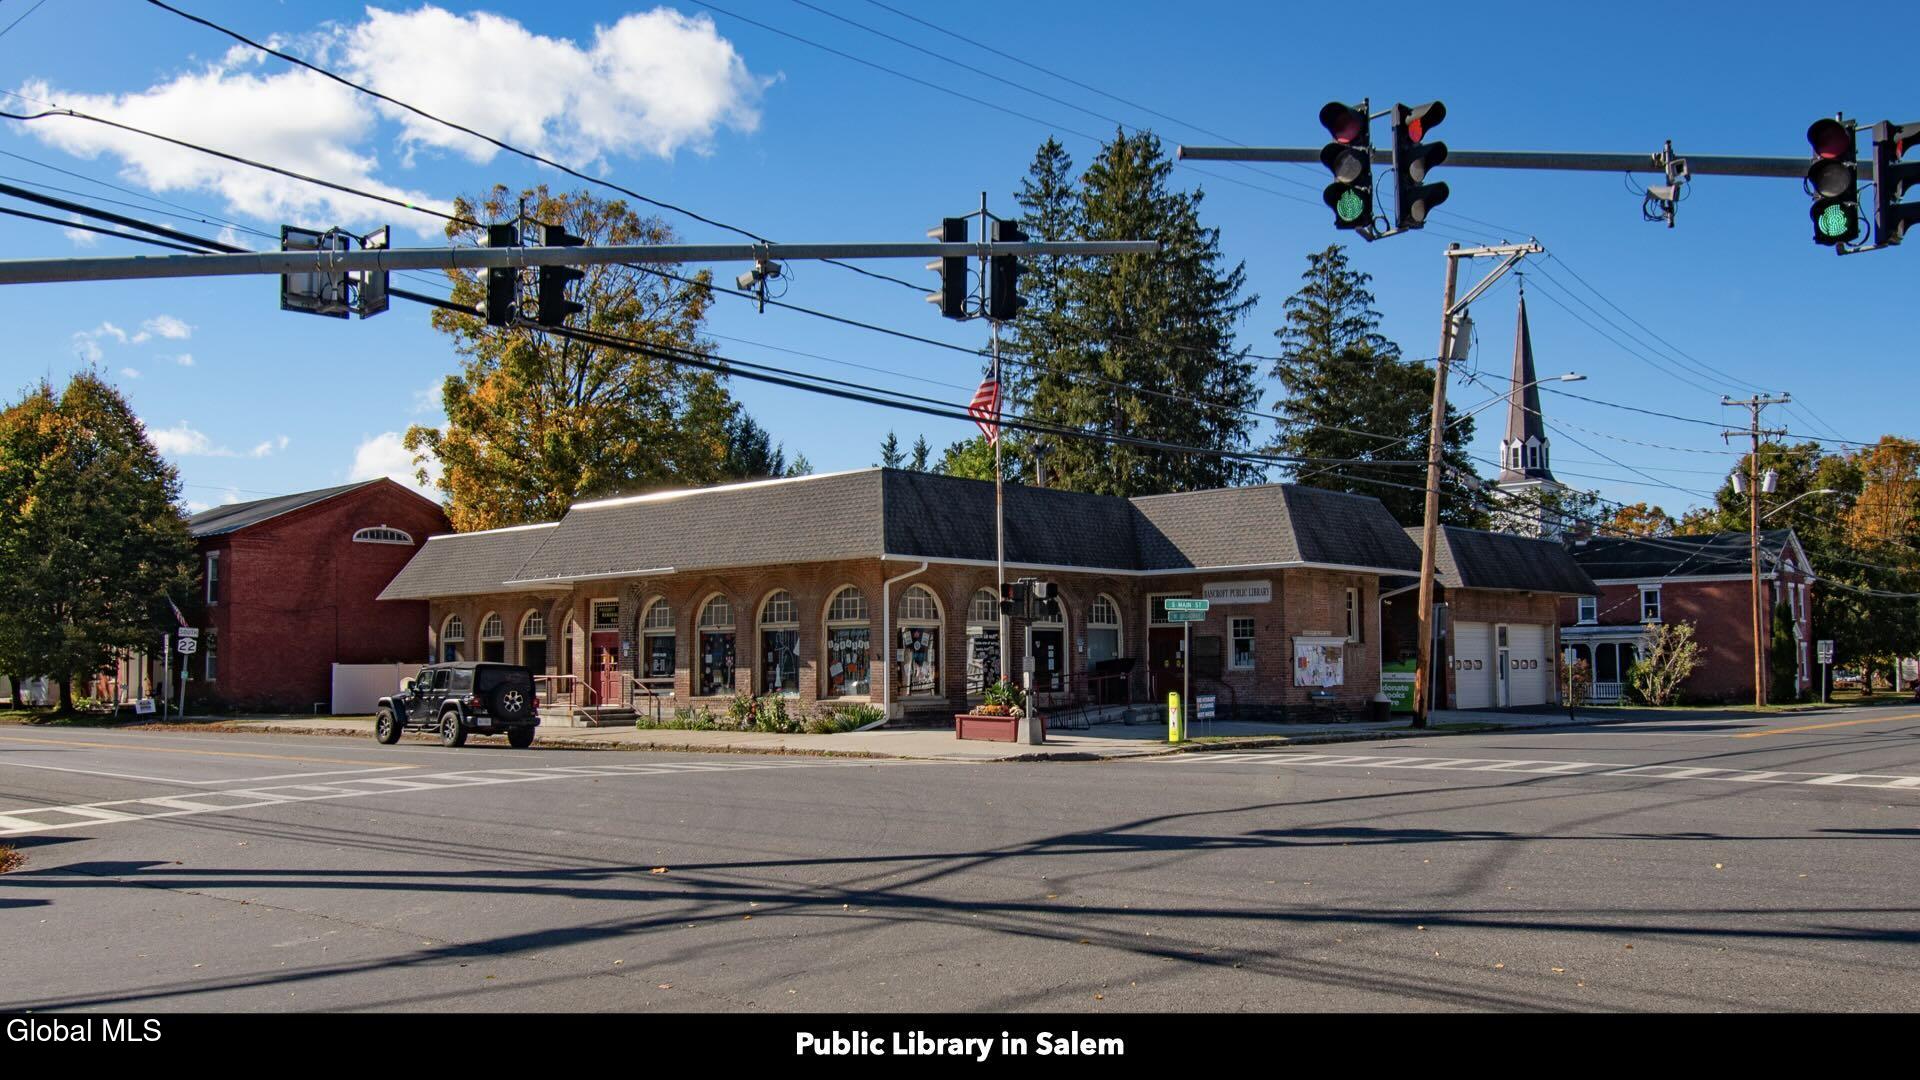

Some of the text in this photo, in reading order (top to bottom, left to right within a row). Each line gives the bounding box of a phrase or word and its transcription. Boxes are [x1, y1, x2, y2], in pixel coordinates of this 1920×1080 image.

[1230, 588, 1247, 597] PUBLIC
[1248, 587, 1269, 597] LIBRARY
[1195, 601, 1202, 609] ST
[179, 640, 195, 651] 22
